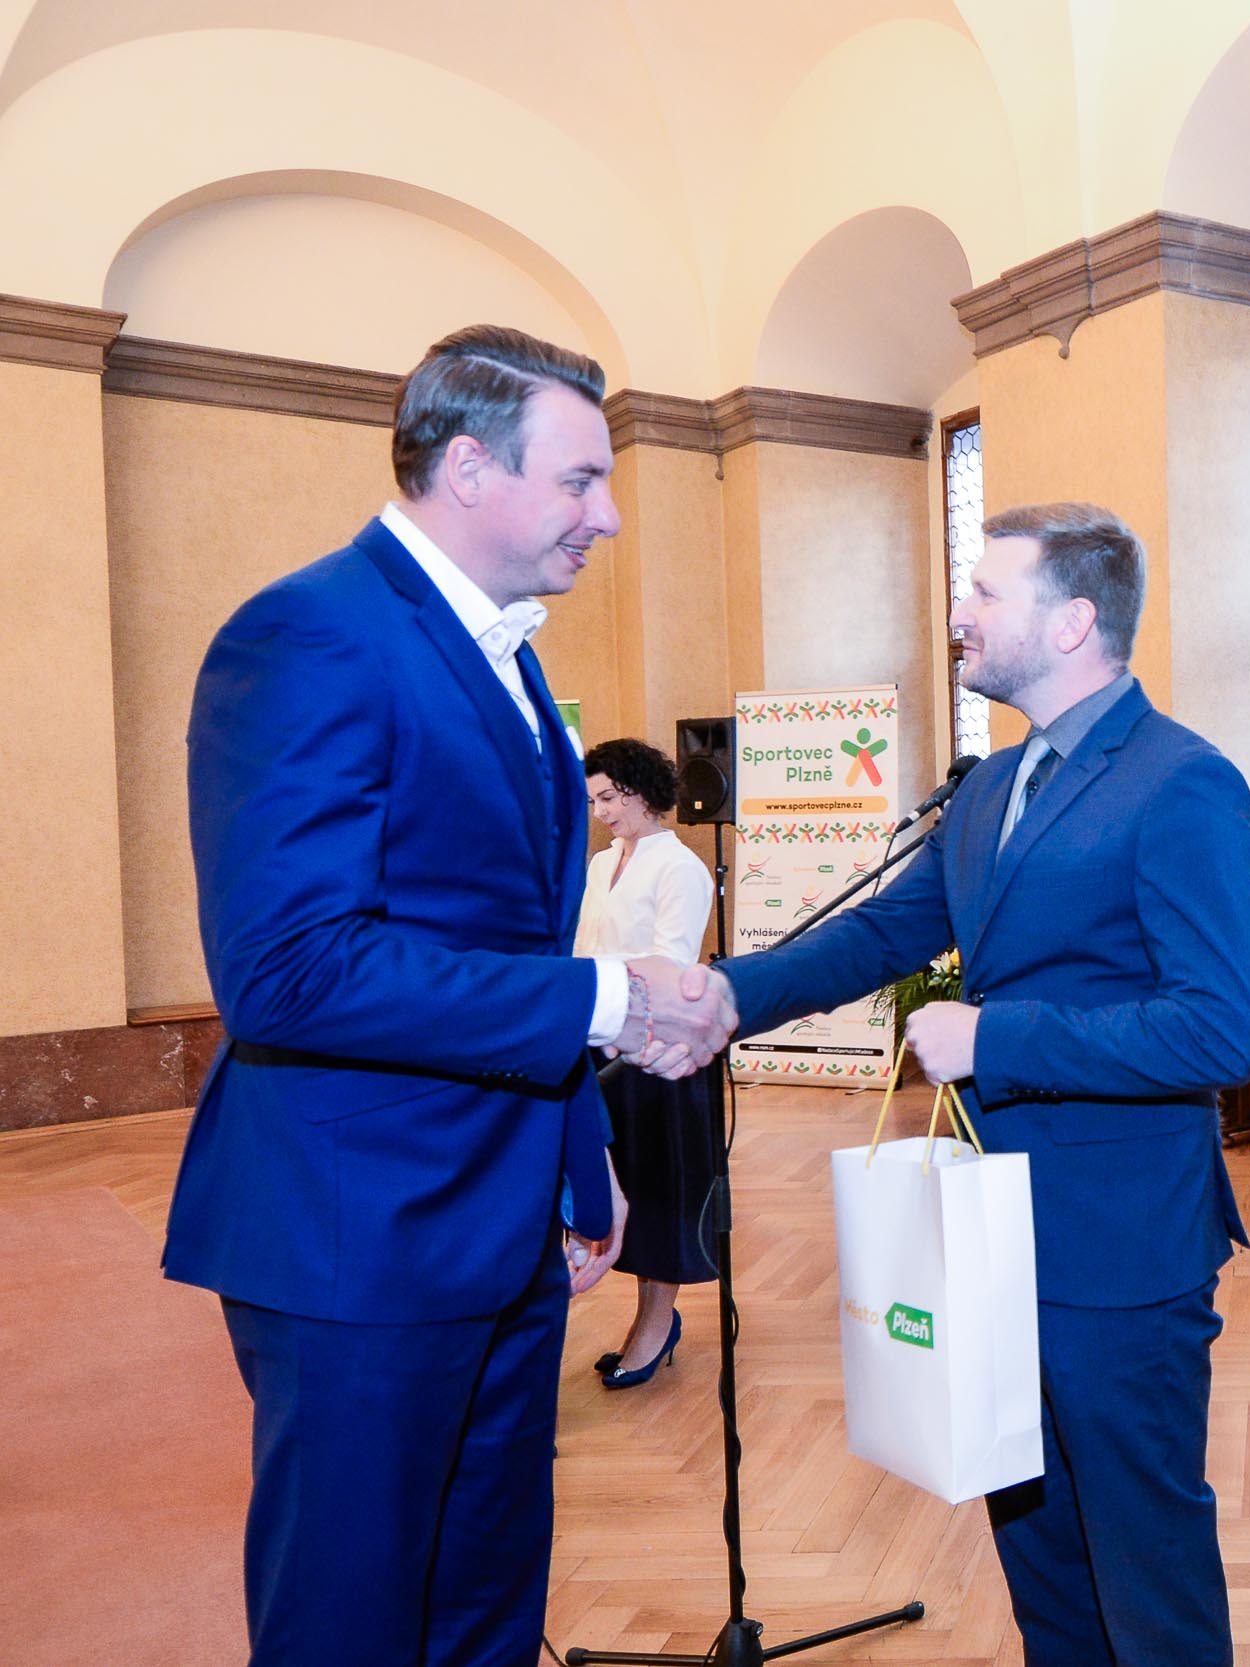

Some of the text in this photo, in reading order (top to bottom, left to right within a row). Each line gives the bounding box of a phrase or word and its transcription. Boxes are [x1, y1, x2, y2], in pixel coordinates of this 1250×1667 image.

[742, 746, 833, 766] Sportovec
[786, 765, 833, 783] Plzně
[765, 801, 863, 812] www.sportovecplzne.cz
[892, 1310, 930, 1341] Plzeň
